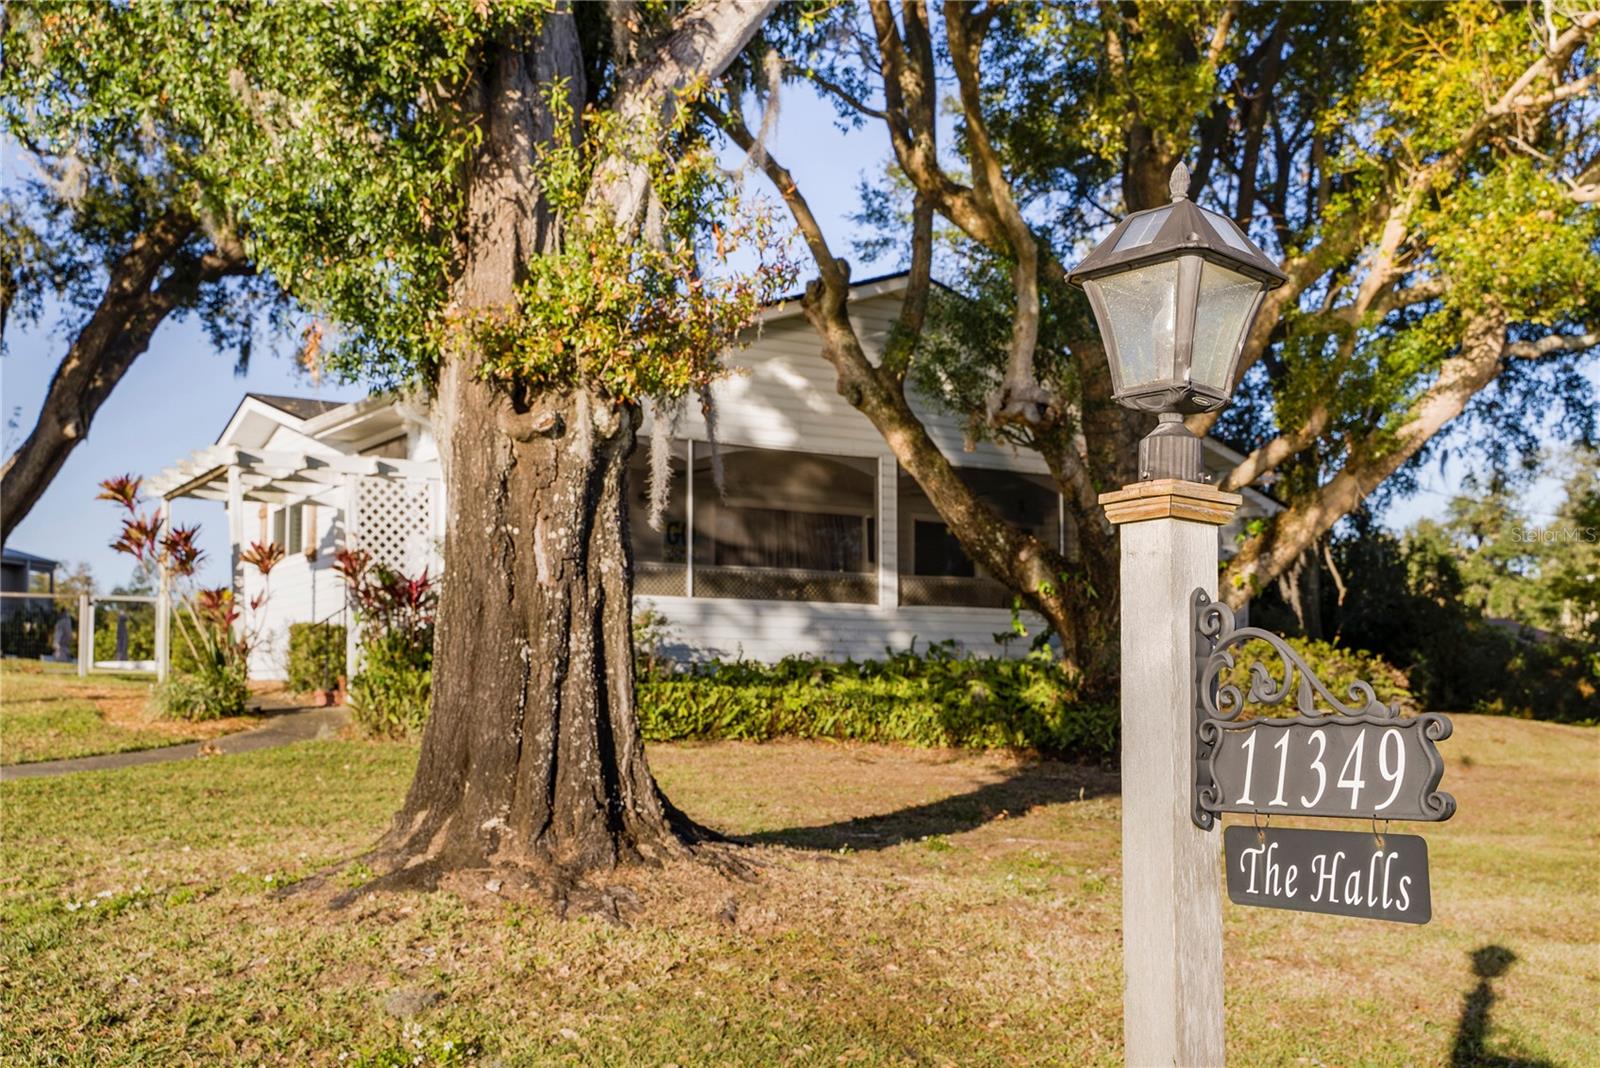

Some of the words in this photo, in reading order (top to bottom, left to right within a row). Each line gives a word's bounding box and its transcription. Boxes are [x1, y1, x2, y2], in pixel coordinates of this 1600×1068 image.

[1235, 728, 1406, 810] 11349
[1240, 842, 1298, 898] The
[1310, 850, 1412, 911] Halls
